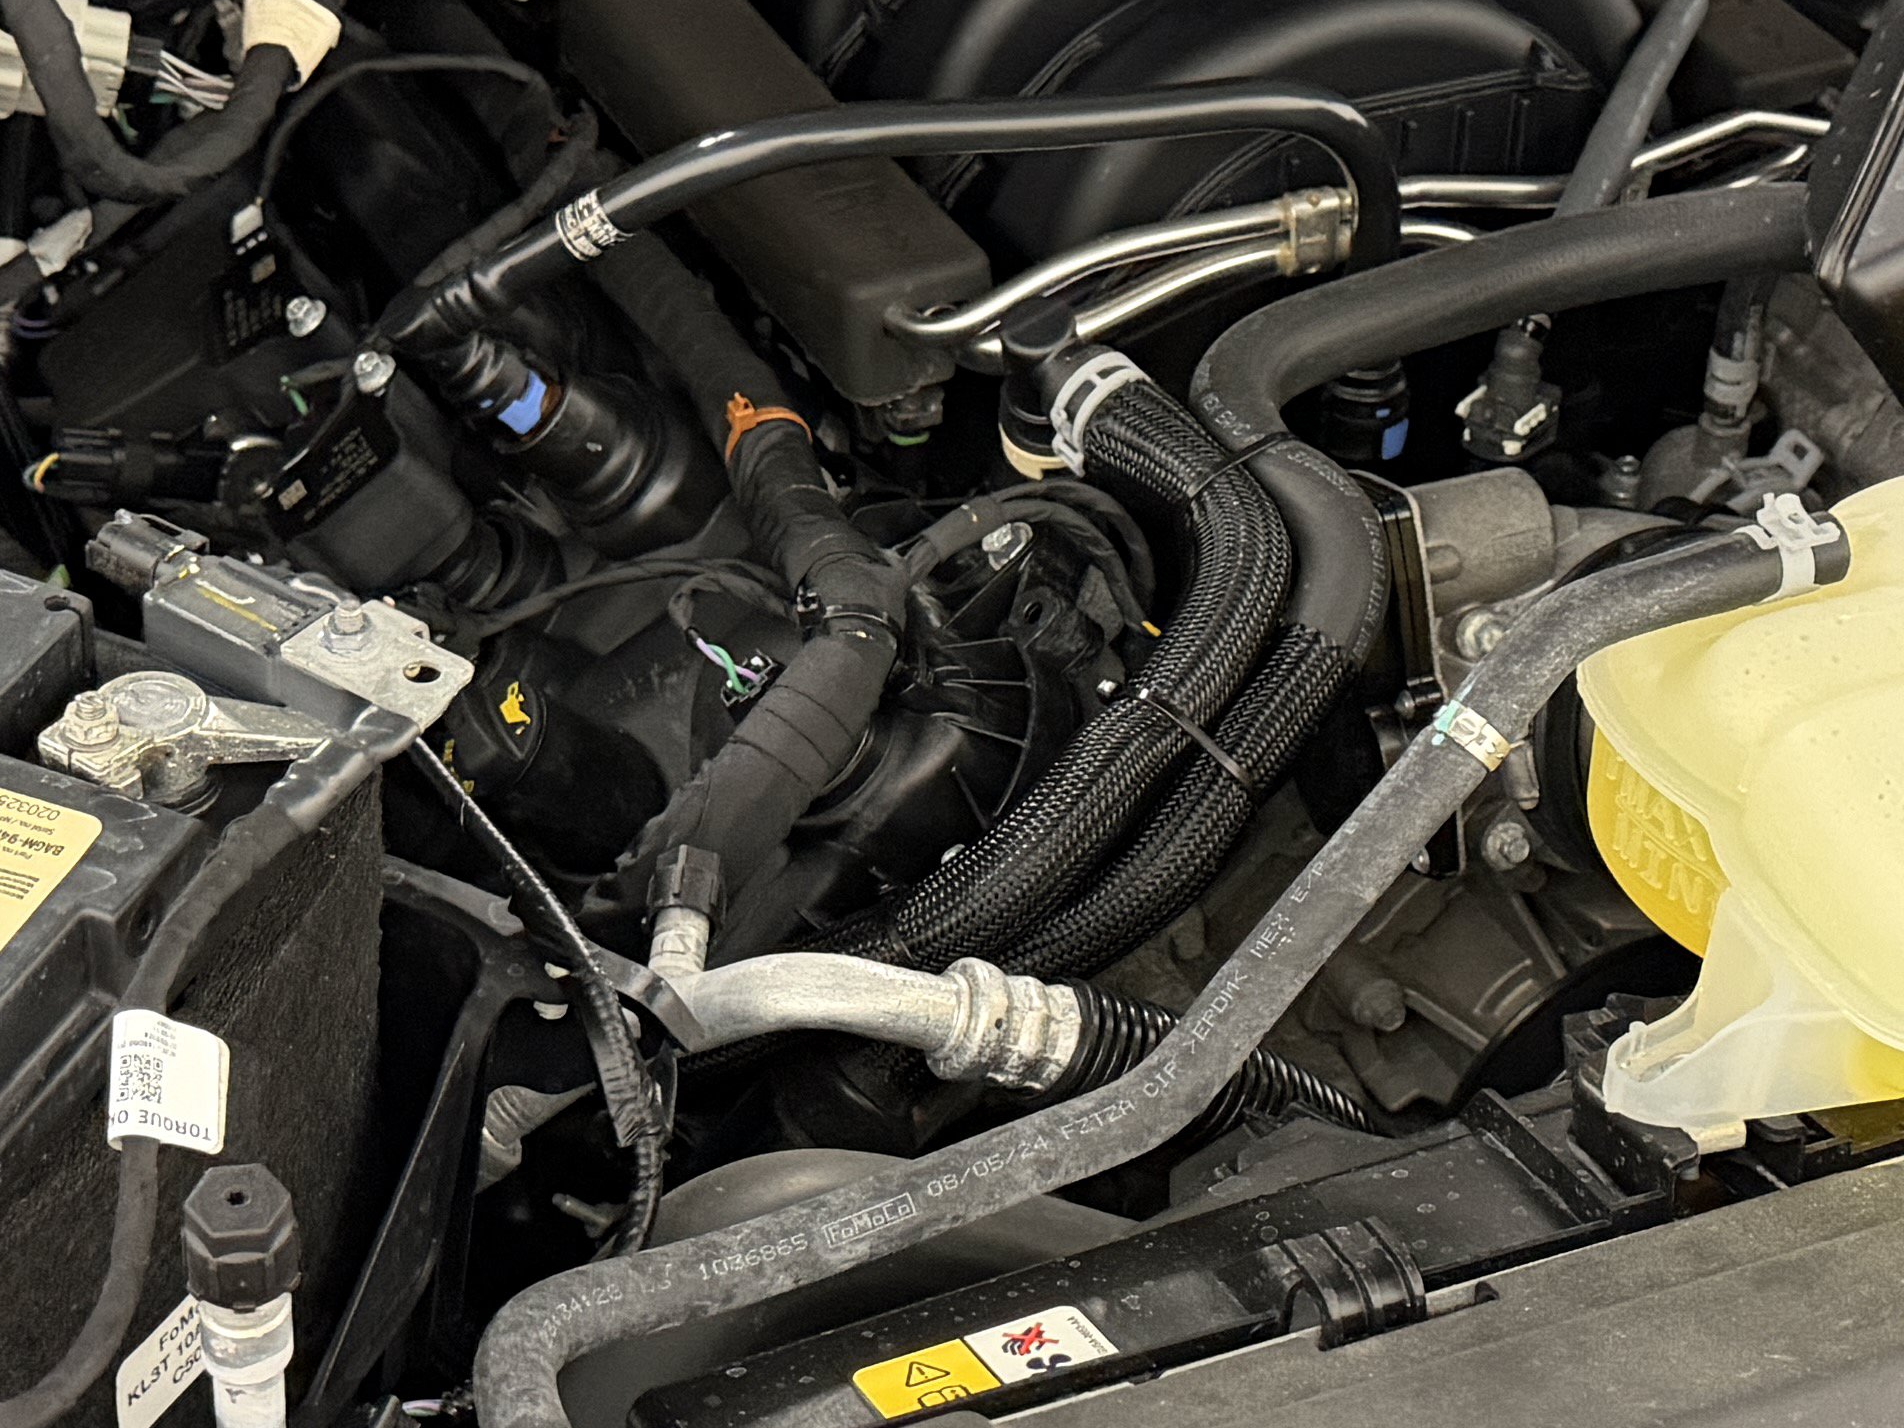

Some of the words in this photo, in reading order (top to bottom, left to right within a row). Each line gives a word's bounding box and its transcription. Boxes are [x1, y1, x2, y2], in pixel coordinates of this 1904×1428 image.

[1612, 811, 1704, 915] MIN
[138, 1109, 213, 1142] TORQUE
[697, 1232, 810, 1282] 1036865
[827, 1199, 913, 1247] FoMoCo
[926, 1134, 1048, 1198] 08/05/24
[1249, 912, 1290, 959] MEX
